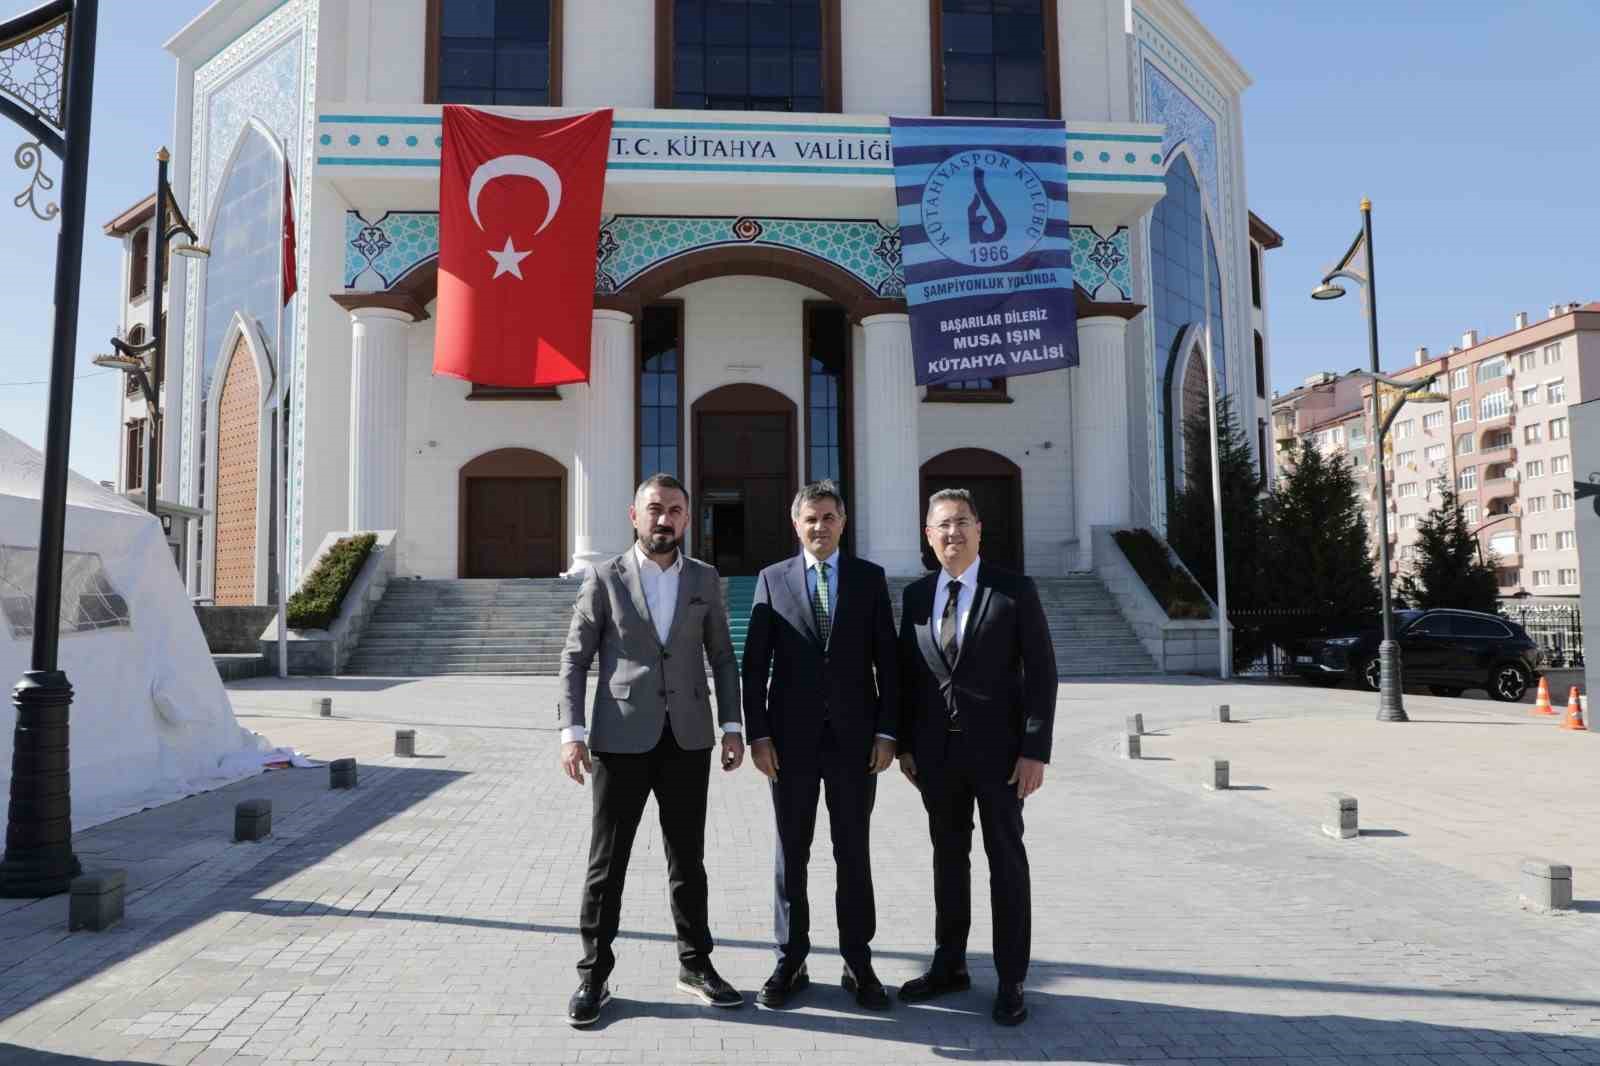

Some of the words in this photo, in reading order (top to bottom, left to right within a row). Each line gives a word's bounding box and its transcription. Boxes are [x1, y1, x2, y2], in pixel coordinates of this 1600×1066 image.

[612, 138, 658, 157] T.C.
[667, 135, 776, 158] KÜTAHYA
[795, 138, 890, 162] VALİLİĞİ
[970, 245, 1009, 263] 1966
[923, 277, 1004, 300] ŞAMPİYONLUK
[1007, 271, 1057, 288] YOLUNDA
[940, 313, 1002, 333] BAŞARILAR
[1005, 307, 1048, 325] DİLERİZ
[953, 333, 1002, 350] MUSA
[1007, 328, 1041, 345] IŞIN
[928, 353, 1006, 373] KÜTAHYA
[1010, 343, 1064, 363] VALİSİ
